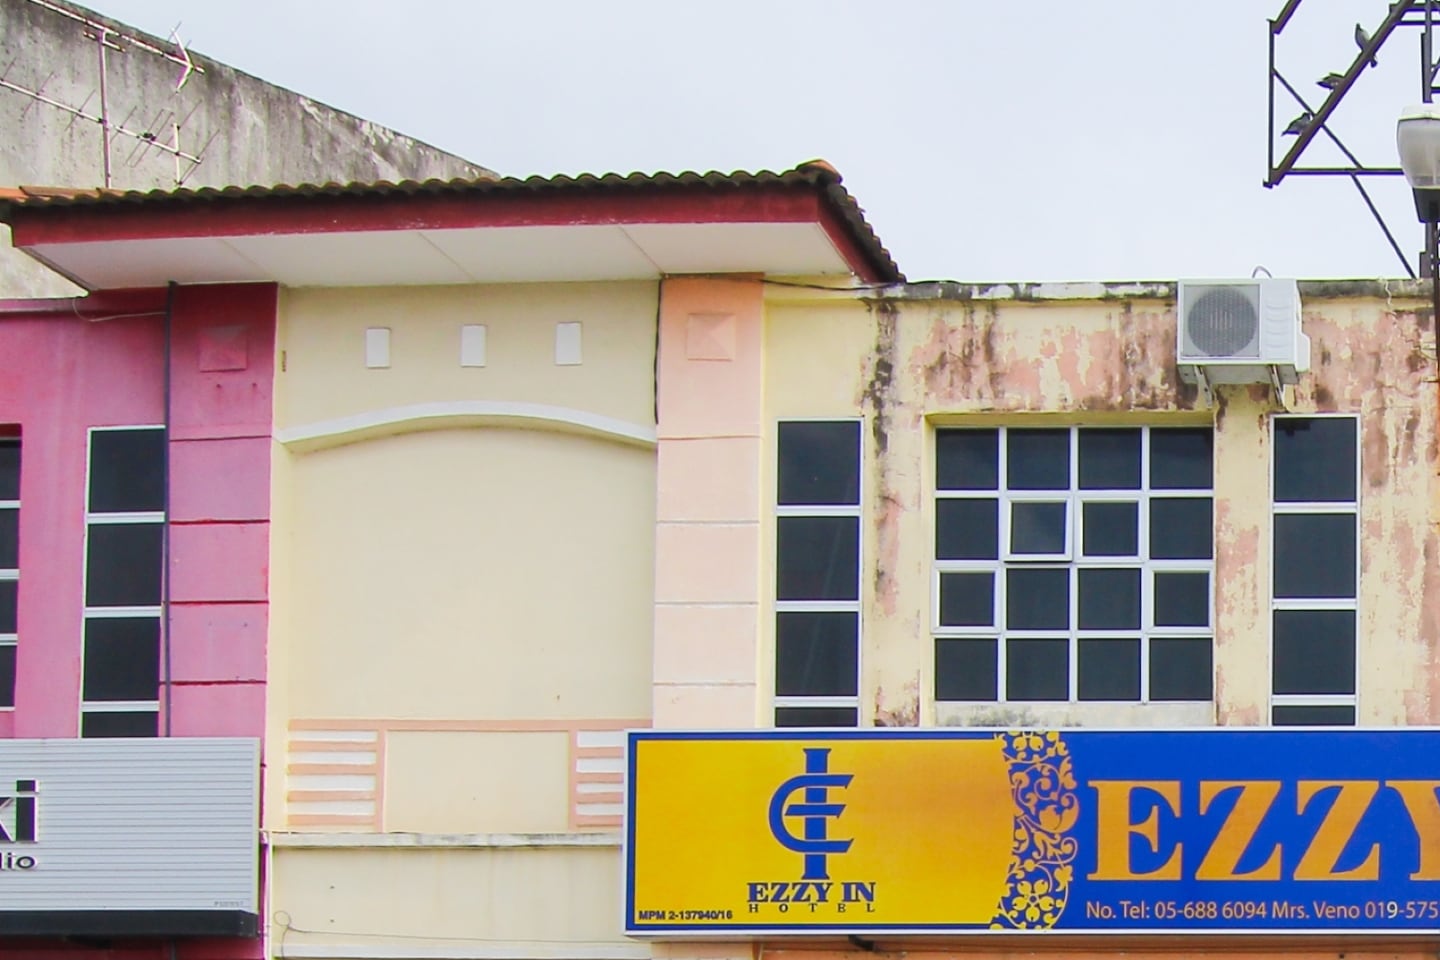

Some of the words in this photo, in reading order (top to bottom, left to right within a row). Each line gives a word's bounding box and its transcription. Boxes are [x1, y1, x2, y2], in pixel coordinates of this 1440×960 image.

[747, 882, 833, 903] EZZY
[841, 882, 876, 903] IN
[748, 903, 876, 913] HOTEL
[1086, 901, 1117, 919] No.
[1119, 901, 1150, 919] Tel:
[1154, 901, 1218, 919] 05-688
[1221, 901, 1267, 919] 6094
[1272, 901, 1310, 919] Mrs.
[1313, 901, 1361, 919] Veno
[638, 911, 666, 920] MPM
